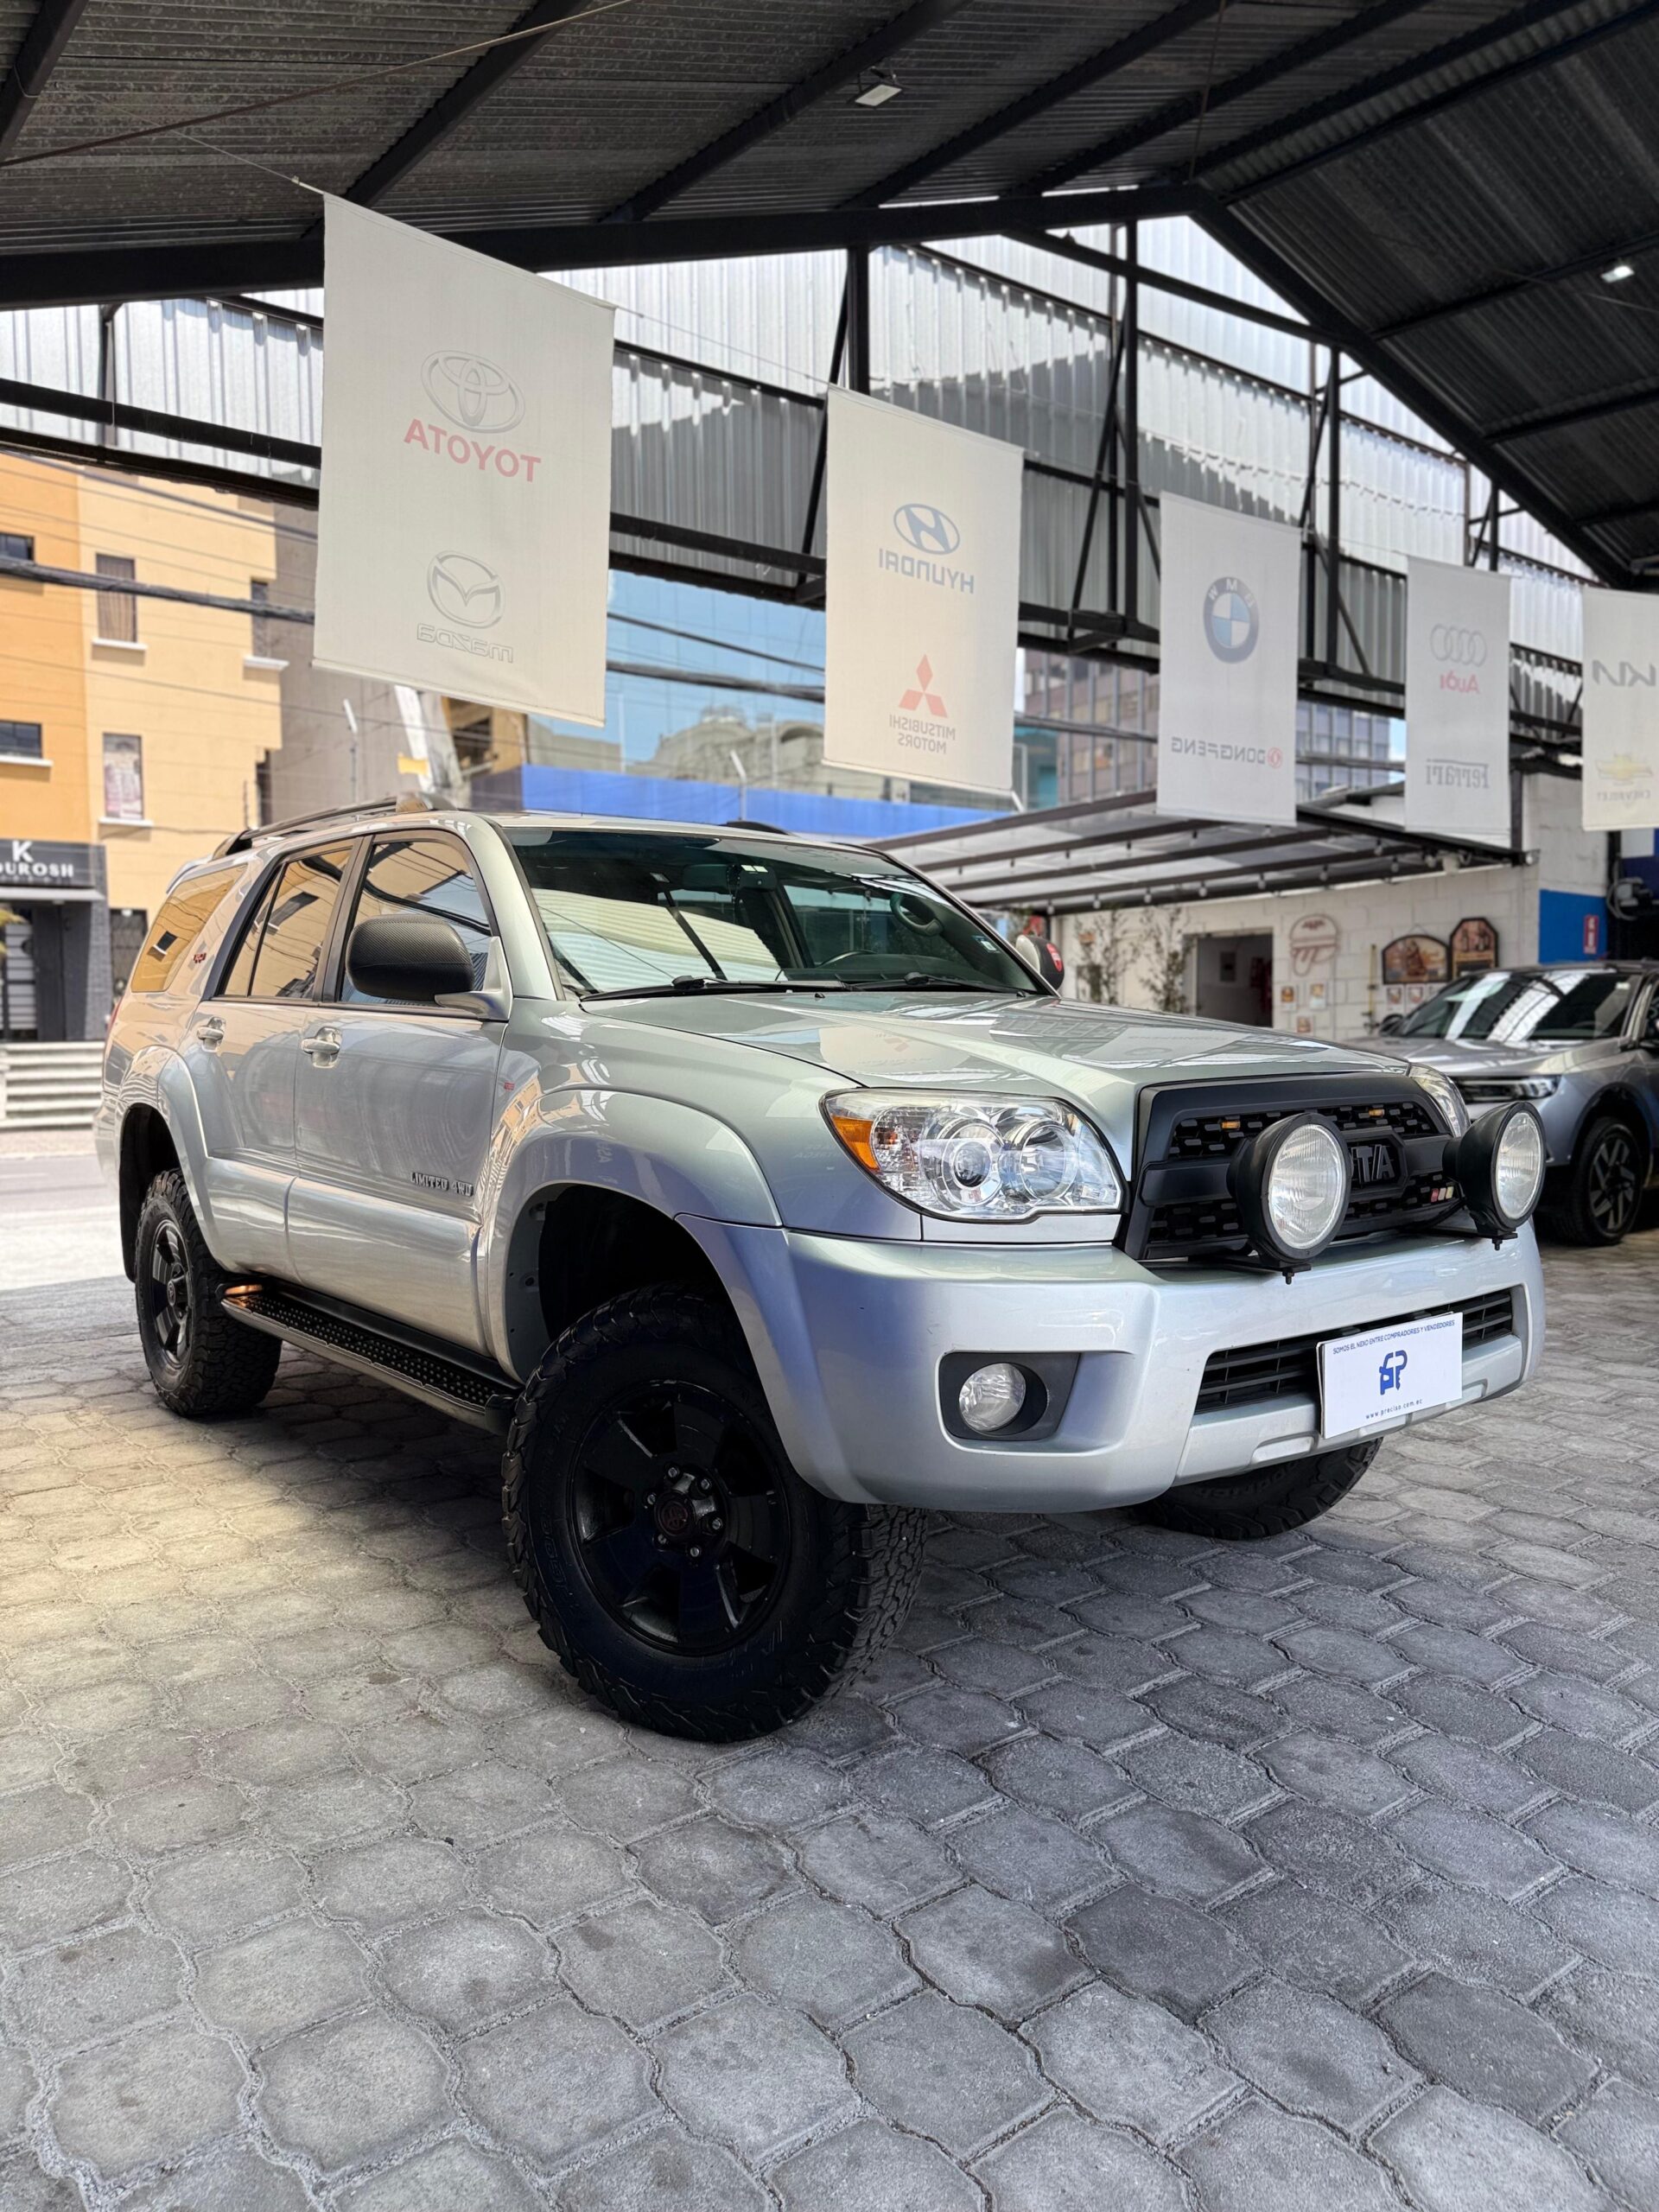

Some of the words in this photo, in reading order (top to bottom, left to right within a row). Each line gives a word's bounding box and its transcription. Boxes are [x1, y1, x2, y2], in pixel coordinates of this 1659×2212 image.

[12, 840, 34, 862] K
[0, 861, 73, 878] UROSH
[410, 1172, 449, 1192] LIMITED
[451, 1179, 474, 1197] 4WD
[1332, 1344, 1350, 1355] SOMOS
[1357, 1339, 1369, 1348] NEXO
[1369, 1336, 1383, 1345] ENTRE
[1383, 1328, 1420, 1342] COMPRADORES
[1424, 1320, 1455, 1332] VENDEDORES
